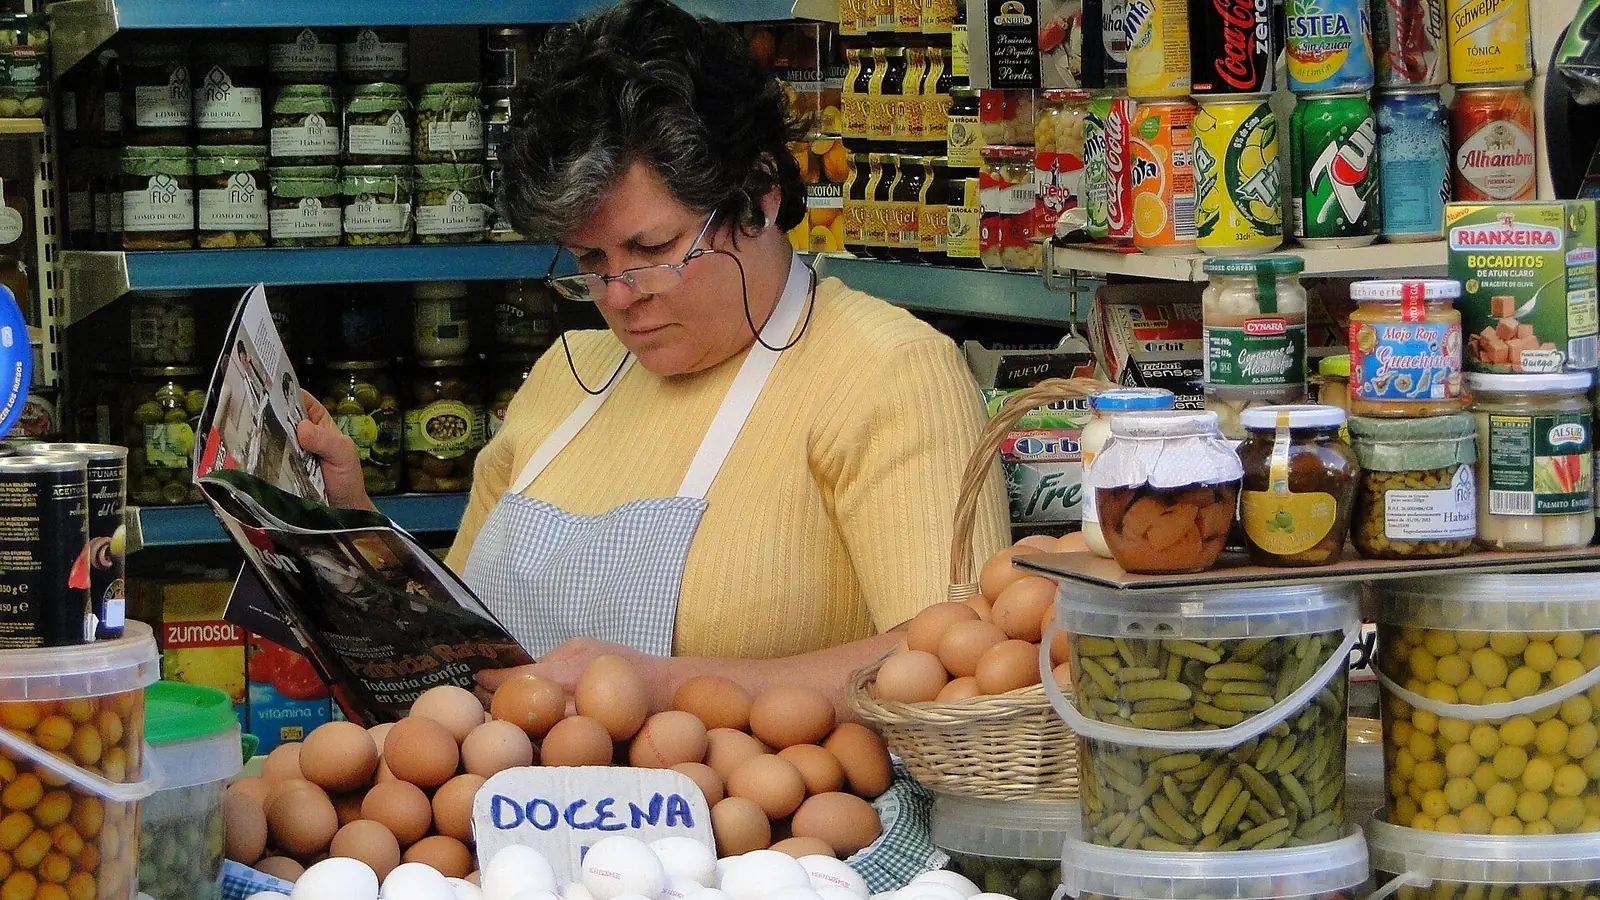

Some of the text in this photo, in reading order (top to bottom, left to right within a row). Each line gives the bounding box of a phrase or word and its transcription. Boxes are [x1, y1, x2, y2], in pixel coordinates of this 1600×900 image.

[1467, 45, 1501, 55] TÓNICA
[1461, 149, 1533, 170] Alhambra
[152, 191, 177, 204] flor
[231, 191, 255, 204] flor
[1458, 230, 1556, 246] RIANXEIRA
[1468, 255, 1545, 268] BOCADITOS
[1477, 270, 1488, 278] DE
[1510, 269, 1535, 278] CLARO
[1247, 322, 1284, 331] CYNARA
[1384, 327, 1438, 343] Mojo Rojo
[1145, 342, 1184, 352] Orbit
[1143, 368, 1203, 378] senses
[1552, 426, 1584, 438] ALSUR
[1537, 499, 1569, 509] PALMITO
[1443, 511, 1470, 523] Habas
[168, 624, 239, 643] ZUMOSOL
[361, 661, 472, 693] Todavía confía
[376, 693, 392, 703] en
[258, 706, 325, 720] vitamina C
[491, 791, 695, 831] DOCENA
